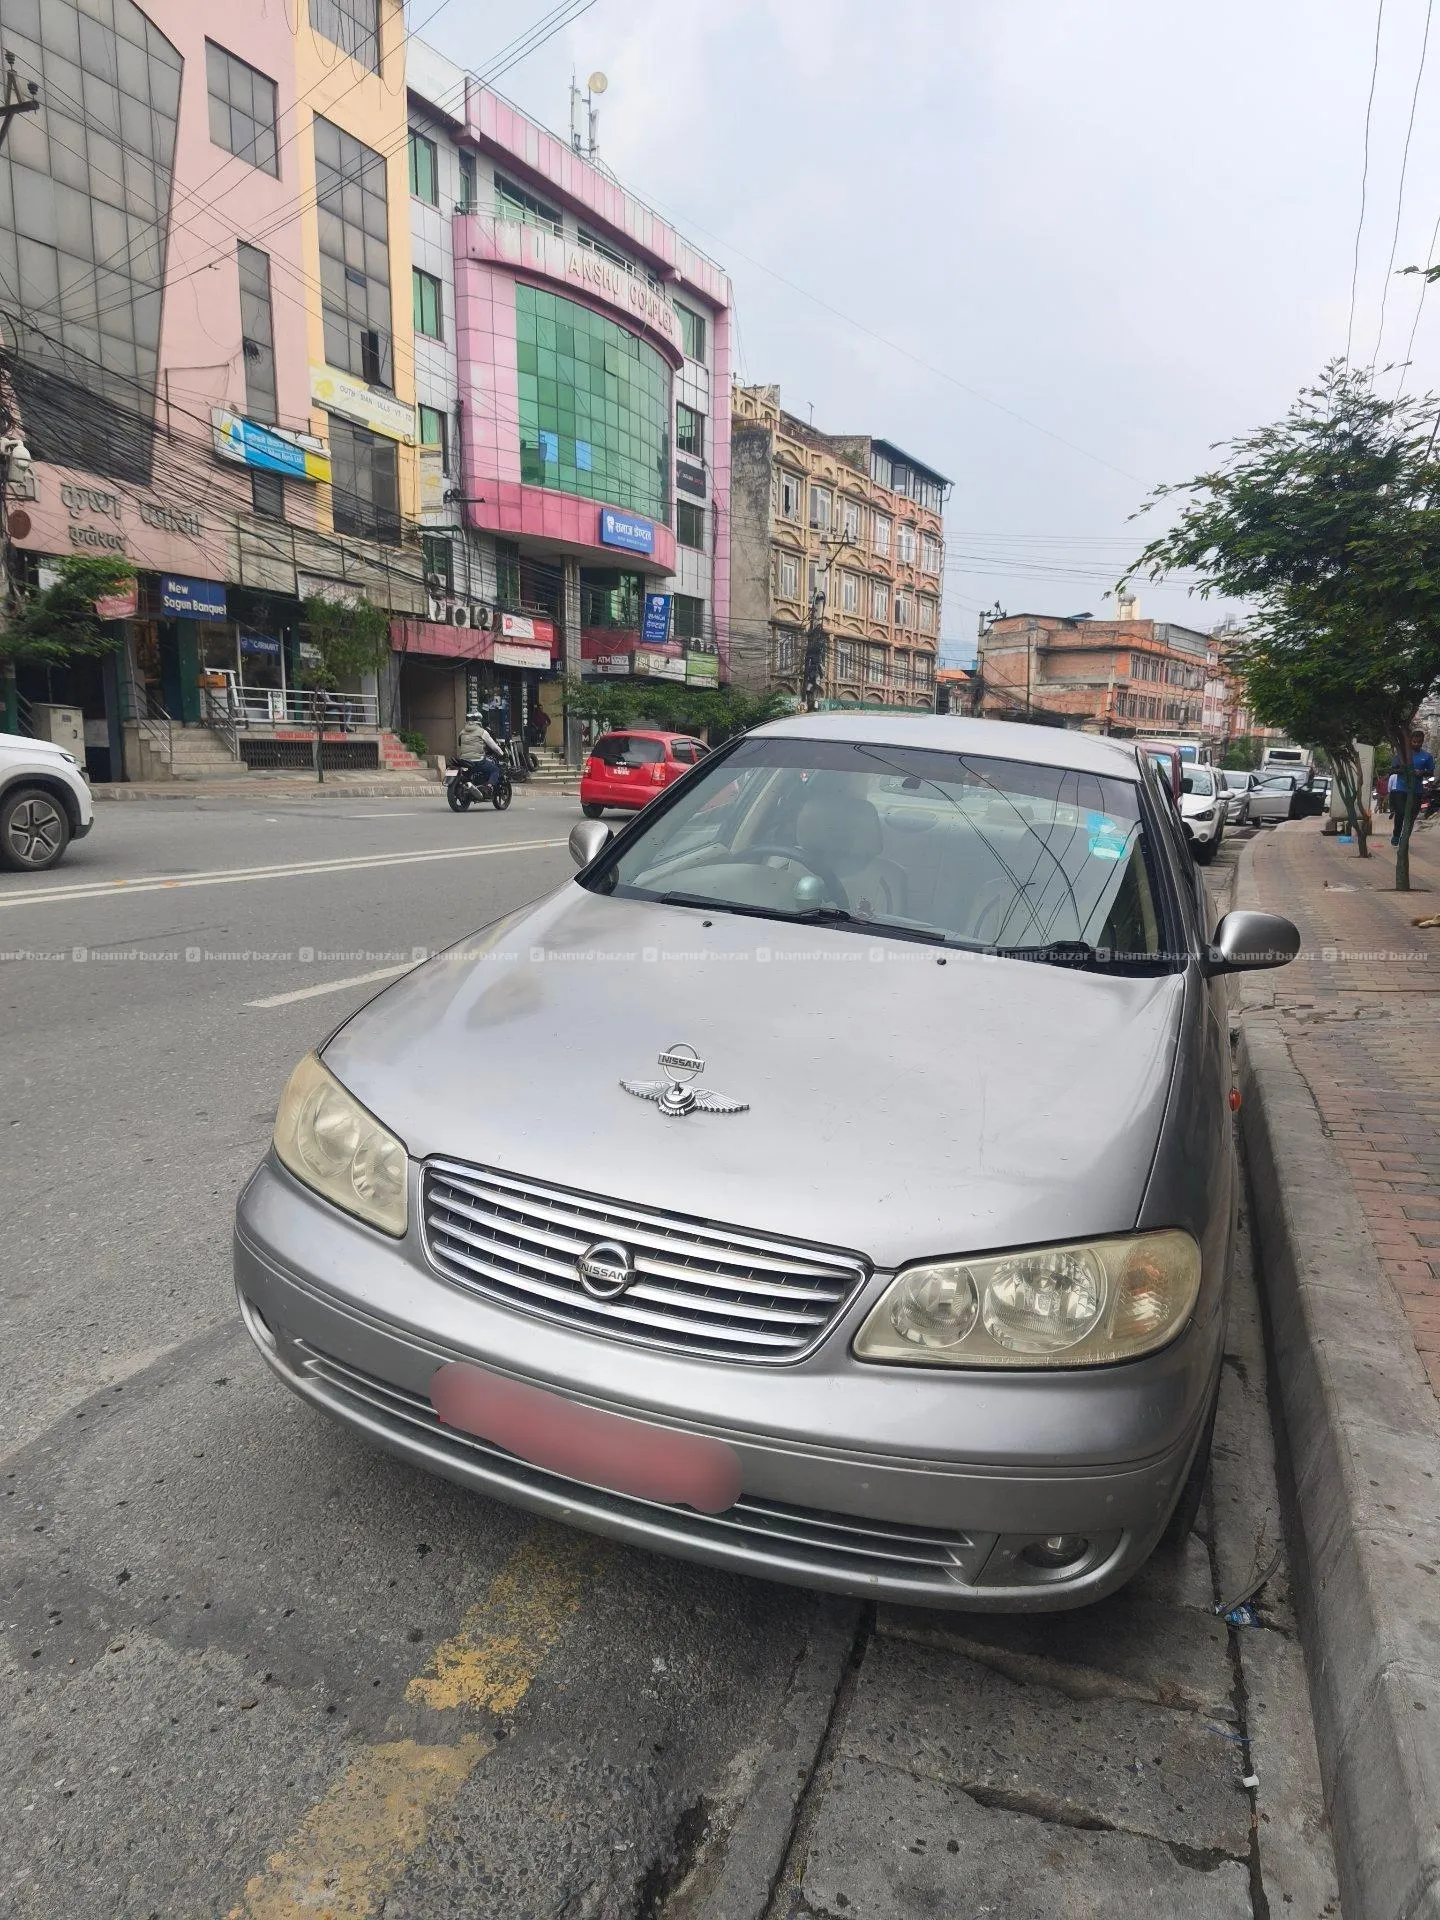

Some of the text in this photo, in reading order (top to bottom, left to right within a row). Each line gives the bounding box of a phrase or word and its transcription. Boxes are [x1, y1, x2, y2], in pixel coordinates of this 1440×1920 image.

[567, 252, 674, 336] ANSHU COMPLEX
[168, 581, 189, 595] New
[163, 595, 192, 611] Sagun
[597, 655, 612, 666] ATM
[661, 1055, 701, 1070] NISSAN
[581, 1262, 627, 1281] NISSAN
